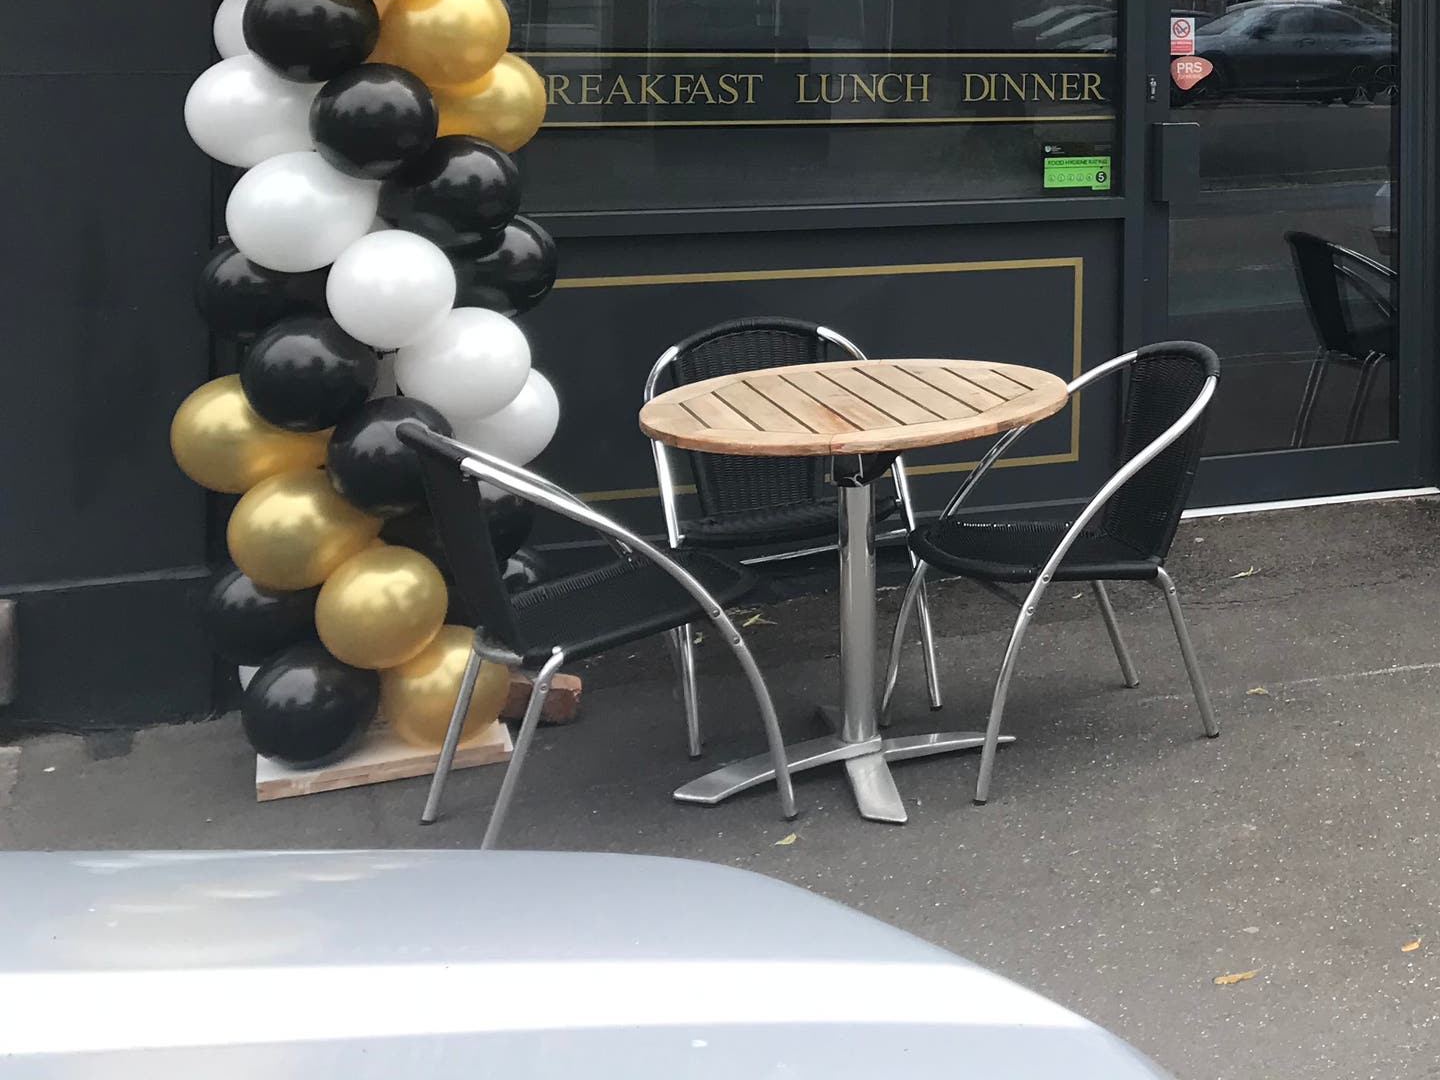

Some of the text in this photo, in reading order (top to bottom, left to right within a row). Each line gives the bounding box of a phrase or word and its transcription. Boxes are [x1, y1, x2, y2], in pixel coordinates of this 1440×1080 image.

[1177, 62, 1202, 73] PRS
[543, 72, 1104, 106] REAKFAST LUNCH DINNER
[1097, 172, 1105, 182] 5
